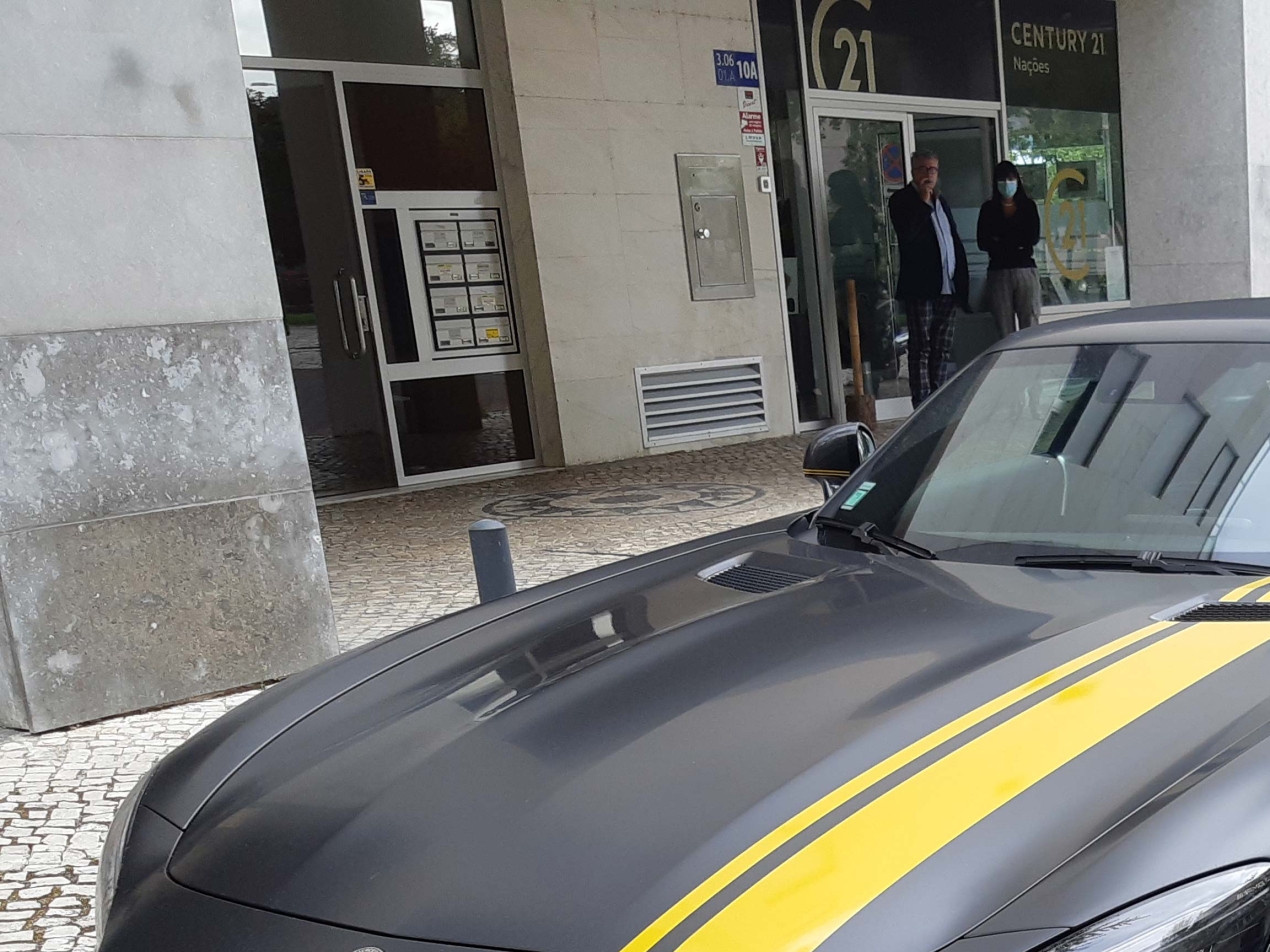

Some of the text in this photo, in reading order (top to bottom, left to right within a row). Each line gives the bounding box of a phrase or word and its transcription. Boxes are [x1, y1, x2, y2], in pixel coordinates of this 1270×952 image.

[1011, 21, 1105, 55] CENTURY 21
[716, 53, 735, 66] 3.06
[1013, 56, 1050, 76] Nações
[736, 60, 758, 80] 10A
